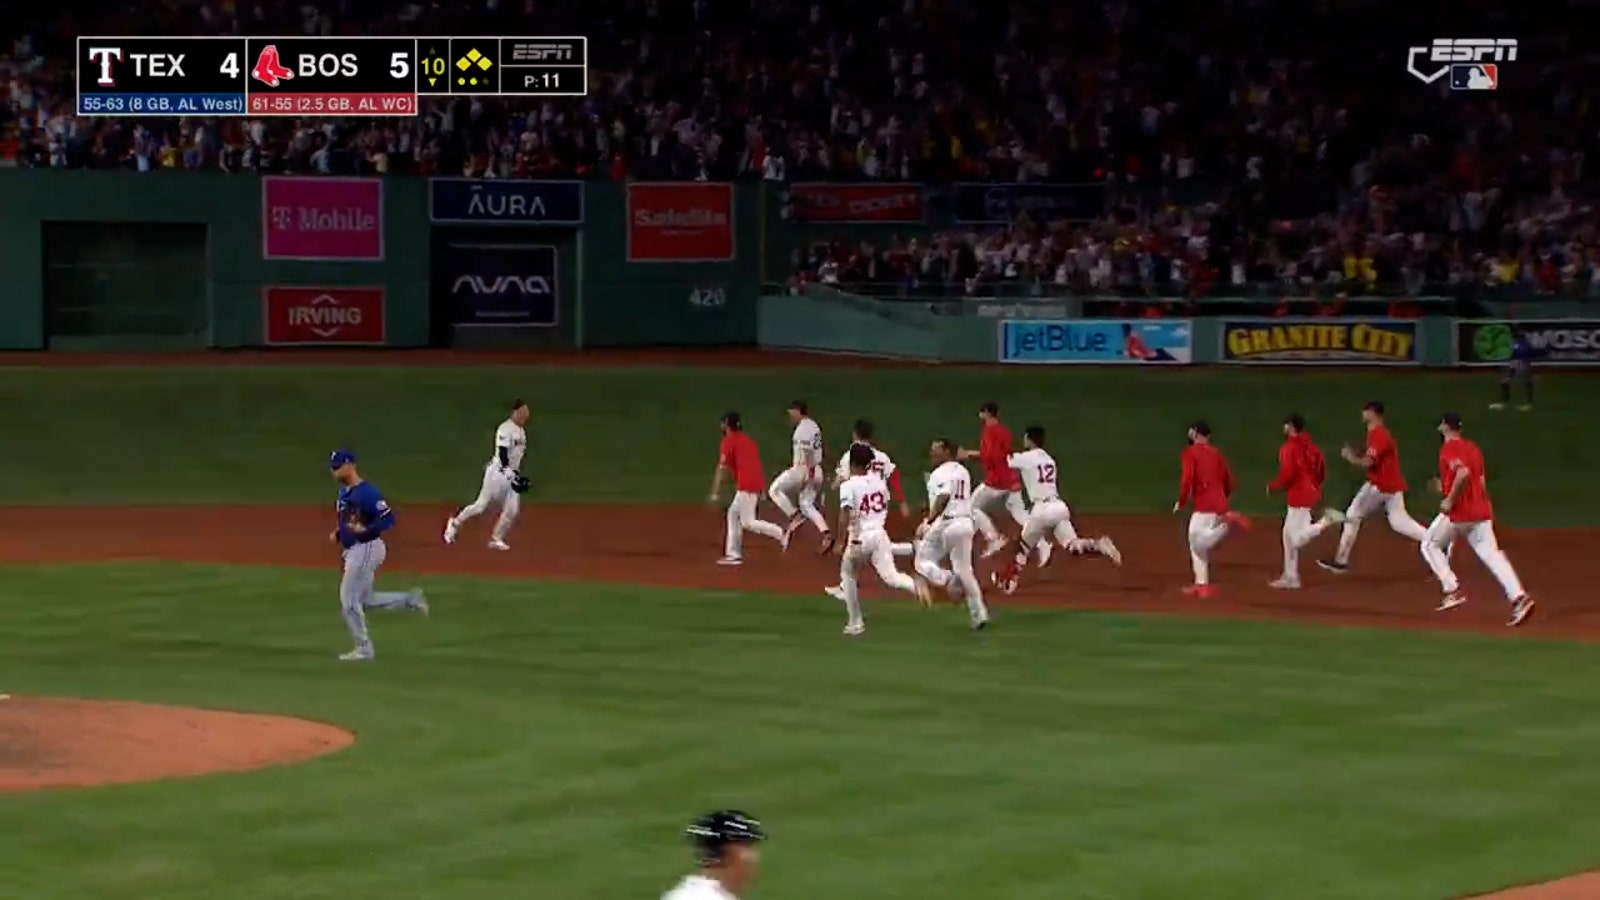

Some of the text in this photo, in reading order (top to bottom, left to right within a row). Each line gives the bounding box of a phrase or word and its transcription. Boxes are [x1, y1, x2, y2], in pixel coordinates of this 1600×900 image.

[298, 206, 375, 231] Mobile
[689, 287, 726, 306] 420
[289, 307, 362, 325] IRVING
[1013, 325, 1107, 357] jetBlue
[1227, 323, 1413, 357] GRANITE CITY
[1037, 464, 1055, 483] 12
[955, 479, 965, 499] 11
[860, 491, 886, 514] 43
